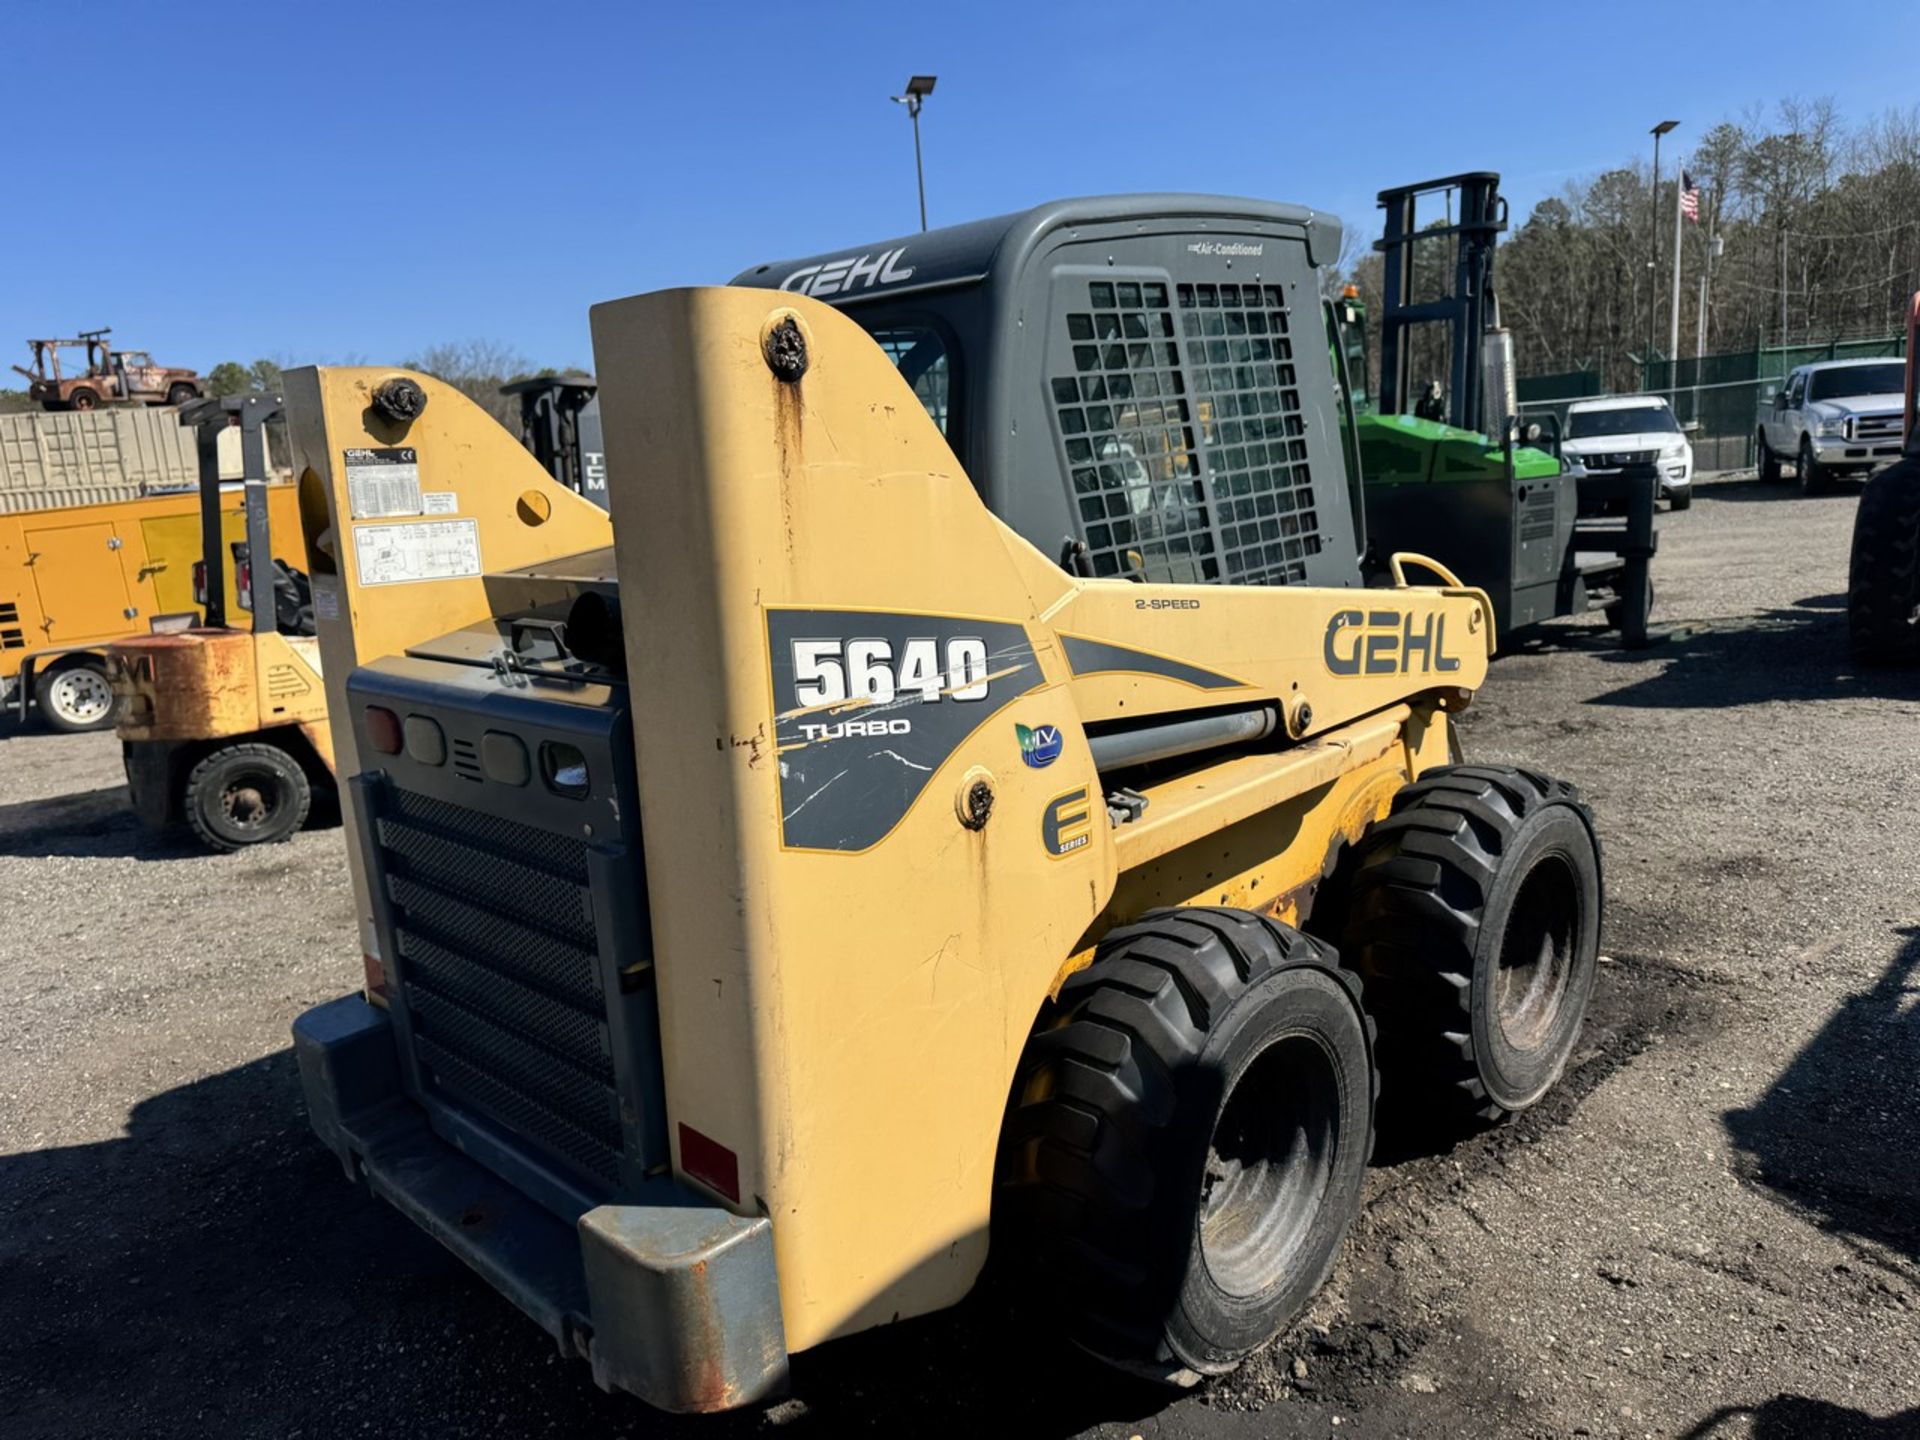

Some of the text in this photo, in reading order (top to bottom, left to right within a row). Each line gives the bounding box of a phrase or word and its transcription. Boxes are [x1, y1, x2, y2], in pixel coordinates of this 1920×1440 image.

[1198, 242, 1263, 256] Air-Conditioned
[779, 247, 914, 296] GEHL
[585, 452, 605, 490] TCM
[1135, 599, 1201, 610] 2-SPEED
[1324, 610, 1461, 675] GEHL
[791, 637, 989, 706] 5640
[798, 718, 912, 741] TURBO
[1060, 835, 1088, 853] SERIES
